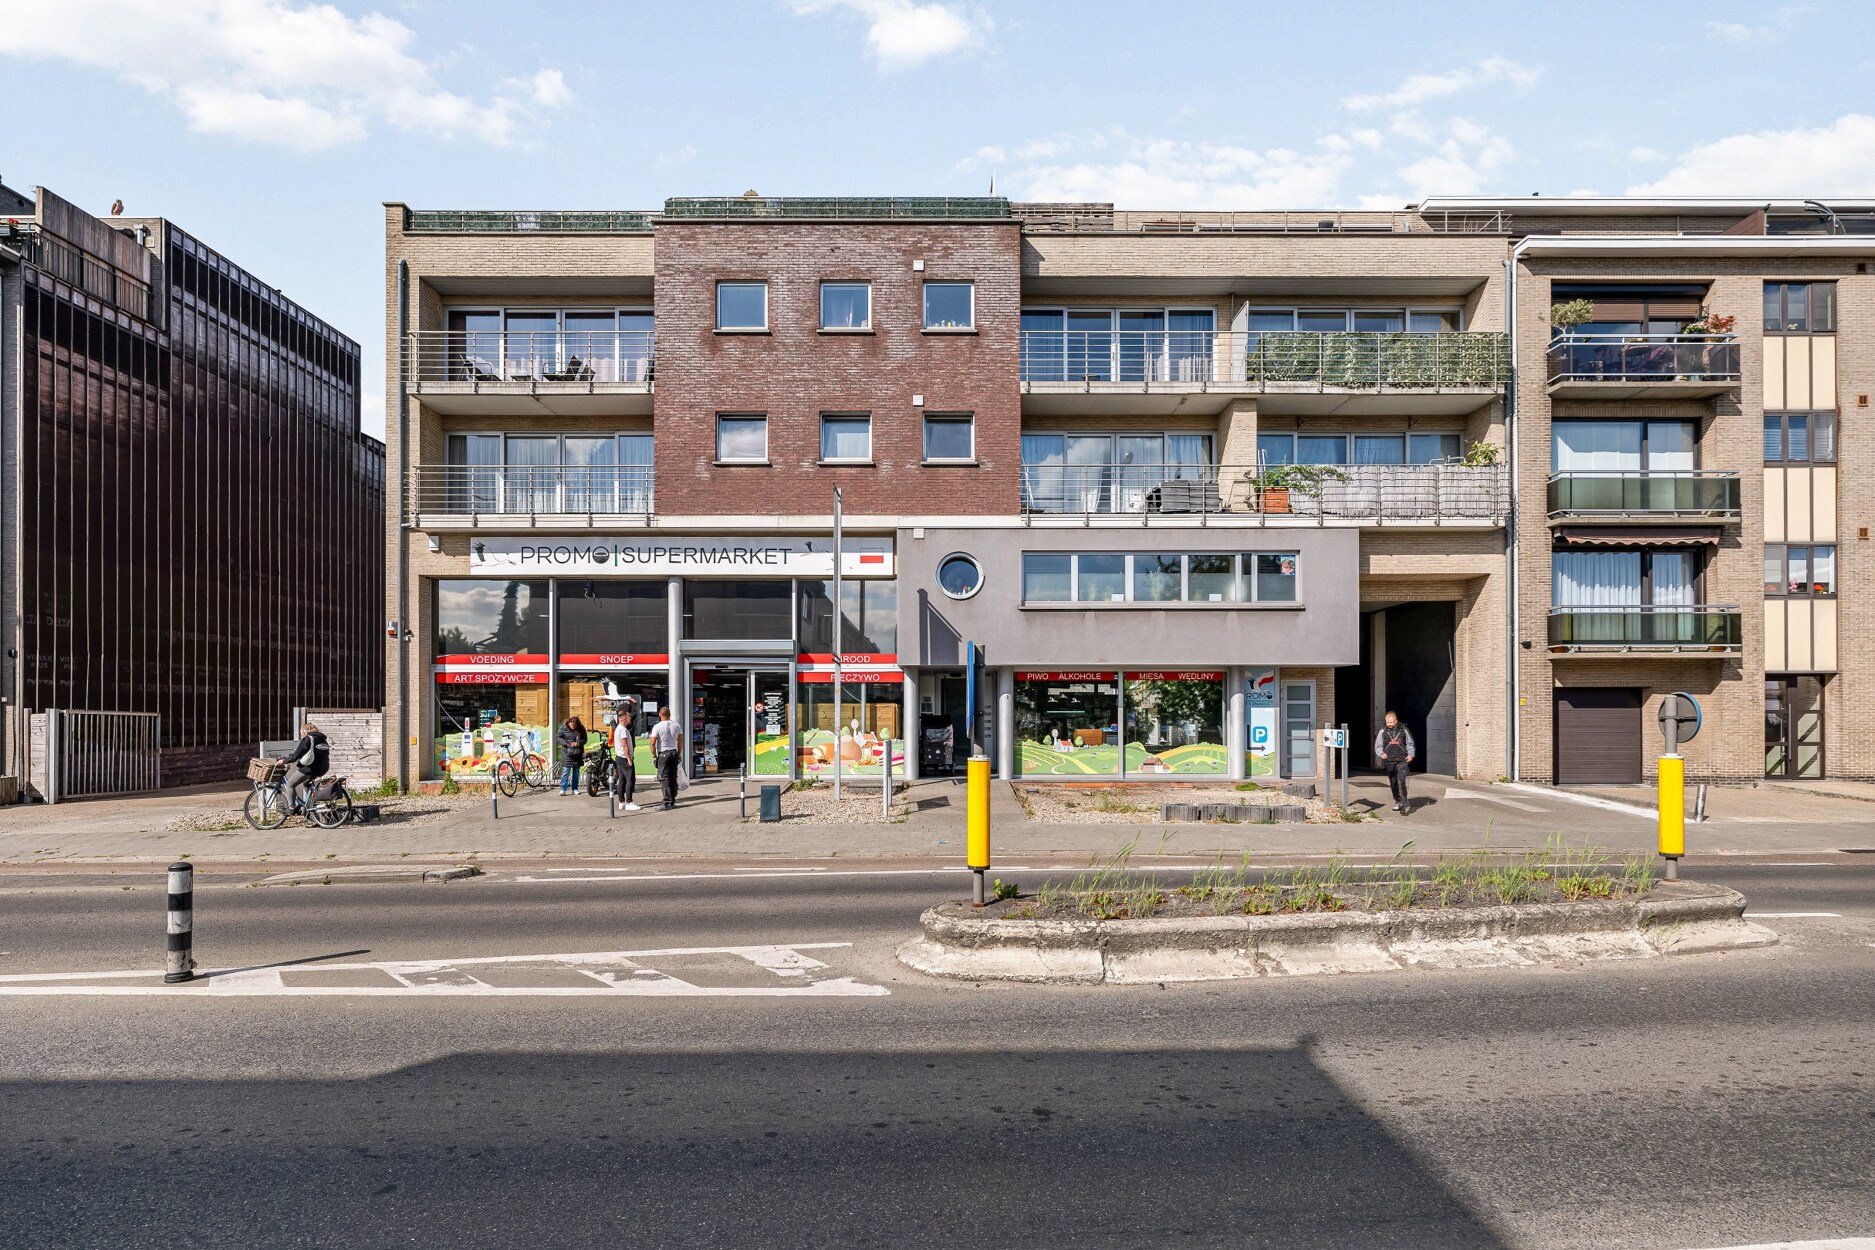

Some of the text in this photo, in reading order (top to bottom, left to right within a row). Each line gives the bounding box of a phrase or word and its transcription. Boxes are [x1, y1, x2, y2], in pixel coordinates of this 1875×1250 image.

[521, 546, 793, 565] PROMO SUPERMARKET
[469, 655, 515, 664] VOEDING
[599, 655, 634, 664] SNOEP
[839, 655, 871, 664] ROOD
[830, 673, 881, 682] PECZYWO
[1027, 672, 1102, 680] PIWO ALKOHOLE
[1245, 691, 1273, 699] ROMO
[1255, 728, 1266, 741] P
